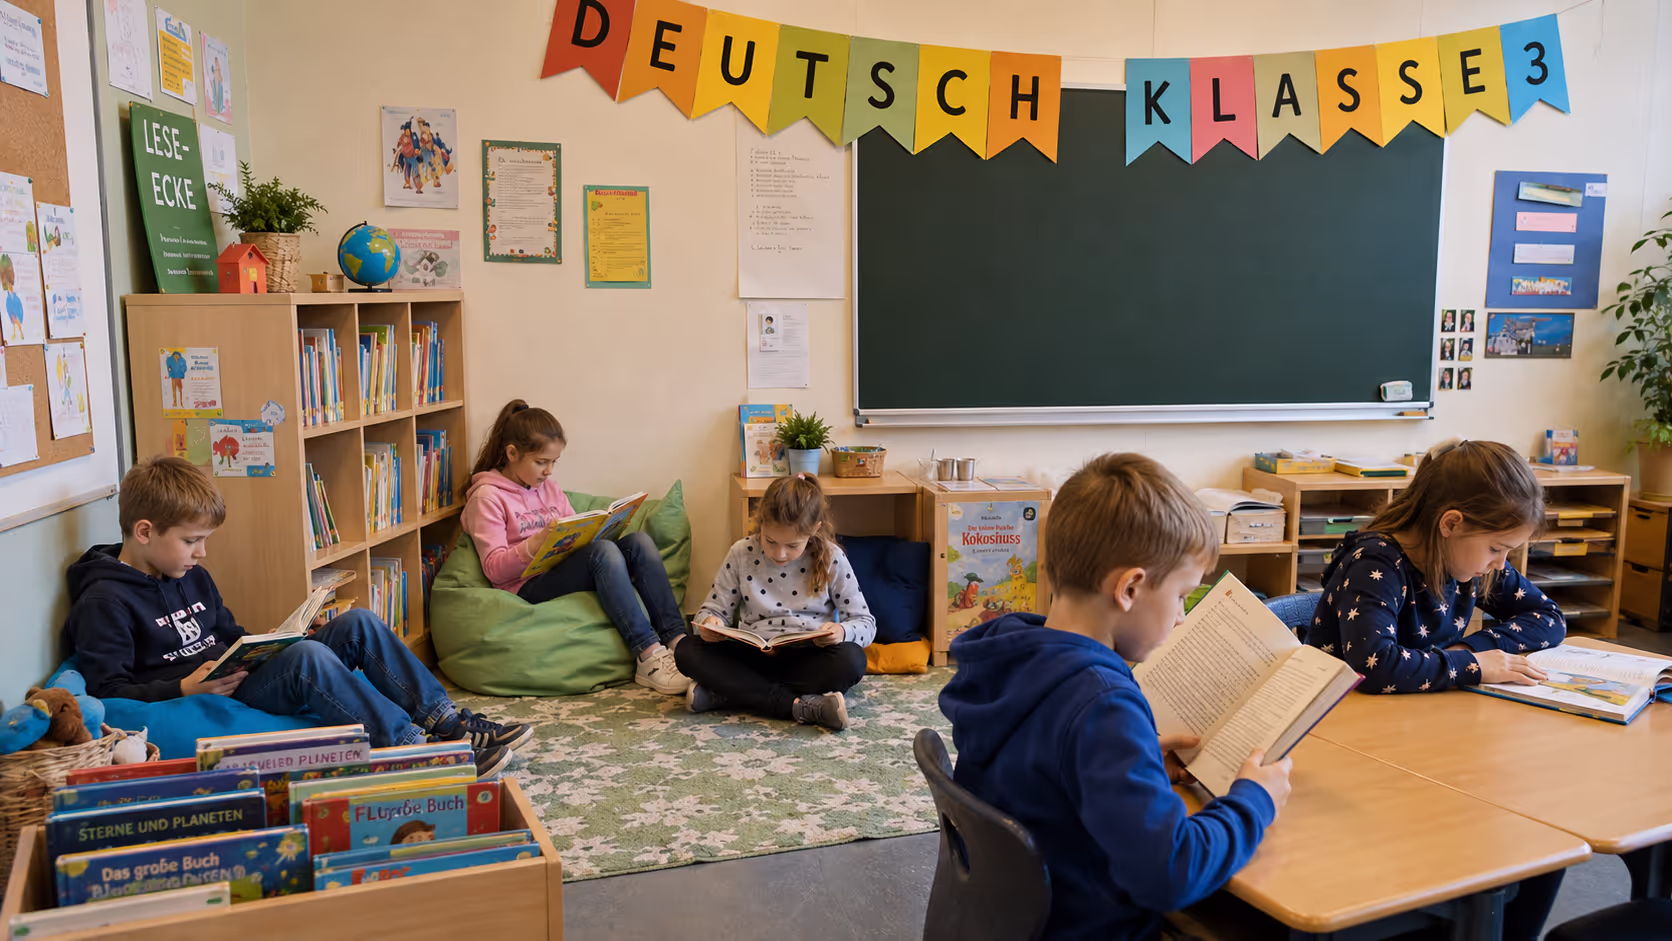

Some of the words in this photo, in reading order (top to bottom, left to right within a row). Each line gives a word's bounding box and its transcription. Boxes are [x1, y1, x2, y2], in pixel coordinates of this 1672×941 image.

[571, 0, 1040, 121] DEUTSCH
[1144, 48, 1486, 126] KLASSE
[1523, 41, 1549, 86] 3
[143, 119, 190, 161] LESE-
[151, 172, 197, 210] ECKE
[427, 795, 464, 813] Buch
[79, 822, 135, 842] STERNE
[138, 818, 169, 834] UND
[172, 809, 243, 828] PLANETEN
[101, 867, 130, 882] Das
[134, 858, 178, 881] große
[182, 852, 220, 870] Buch
